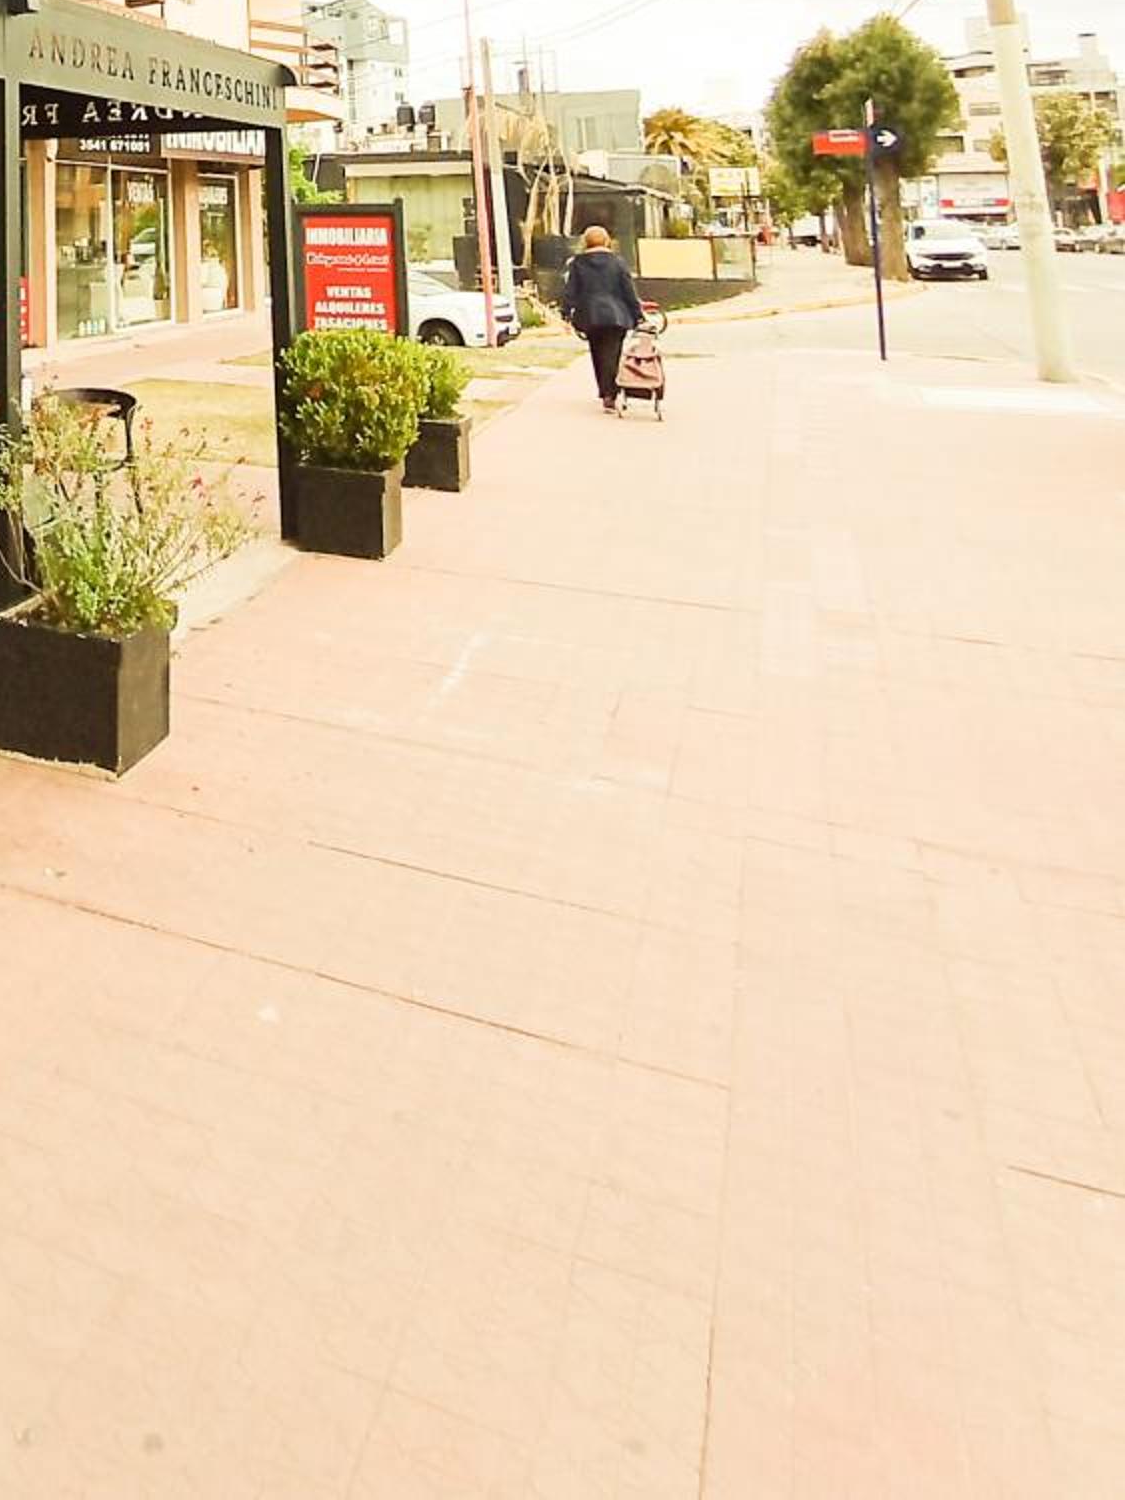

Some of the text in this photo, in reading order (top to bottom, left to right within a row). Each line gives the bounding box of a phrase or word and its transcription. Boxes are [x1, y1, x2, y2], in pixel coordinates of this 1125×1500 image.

[29, 28, 135, 81] ANDREA
[79, 139, 107, 151] 3541
[326, 286, 372, 298] VENTAS
